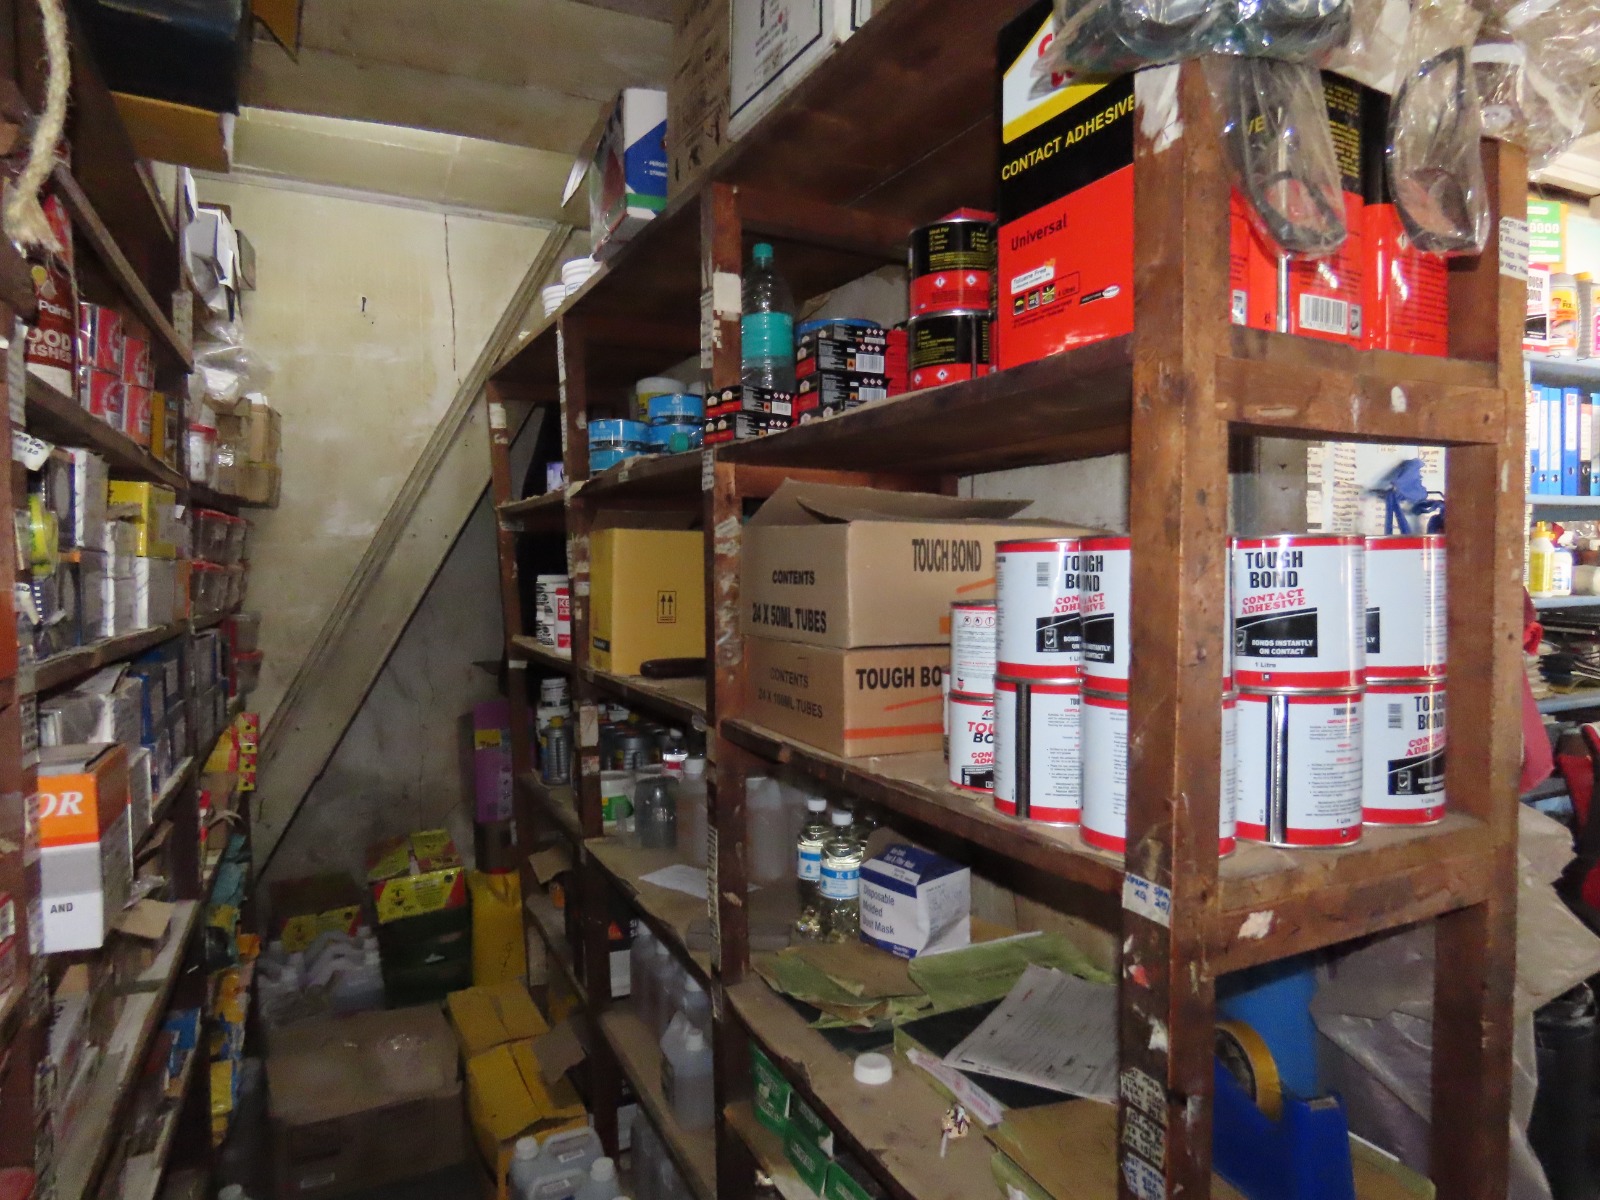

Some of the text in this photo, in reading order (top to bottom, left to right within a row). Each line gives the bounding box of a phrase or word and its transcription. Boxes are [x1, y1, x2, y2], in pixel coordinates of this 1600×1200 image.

[1001, 93, 1135, 181] CONTACT ADHESIVE
[1010, 212, 1068, 251] Universal
[912, 538, 982, 572] TOUGH BOND
[1245, 551, 1303, 569] TOUGH
[772, 570, 815, 585] CONTENTS
[1250, 571, 1298, 588] BOND
[1241, 598, 1306, 614] ADHESIVE
[1242, 589, 1304, 605] CONTACT
[752, 603, 827, 634] 24 X 50ML TUBES
[1251, 639, 1313, 647] BONDS INSTANTLY
[770, 667, 808, 688] CONTENTS
[856, 668, 914, 690] TOUGH
[796, 700, 823, 719] TUBES
[862, 884, 895, 906] Disposable
[50, 902, 74, 914] AND
[862, 900, 883, 917] Molded
[874, 921, 895, 935] Mask
